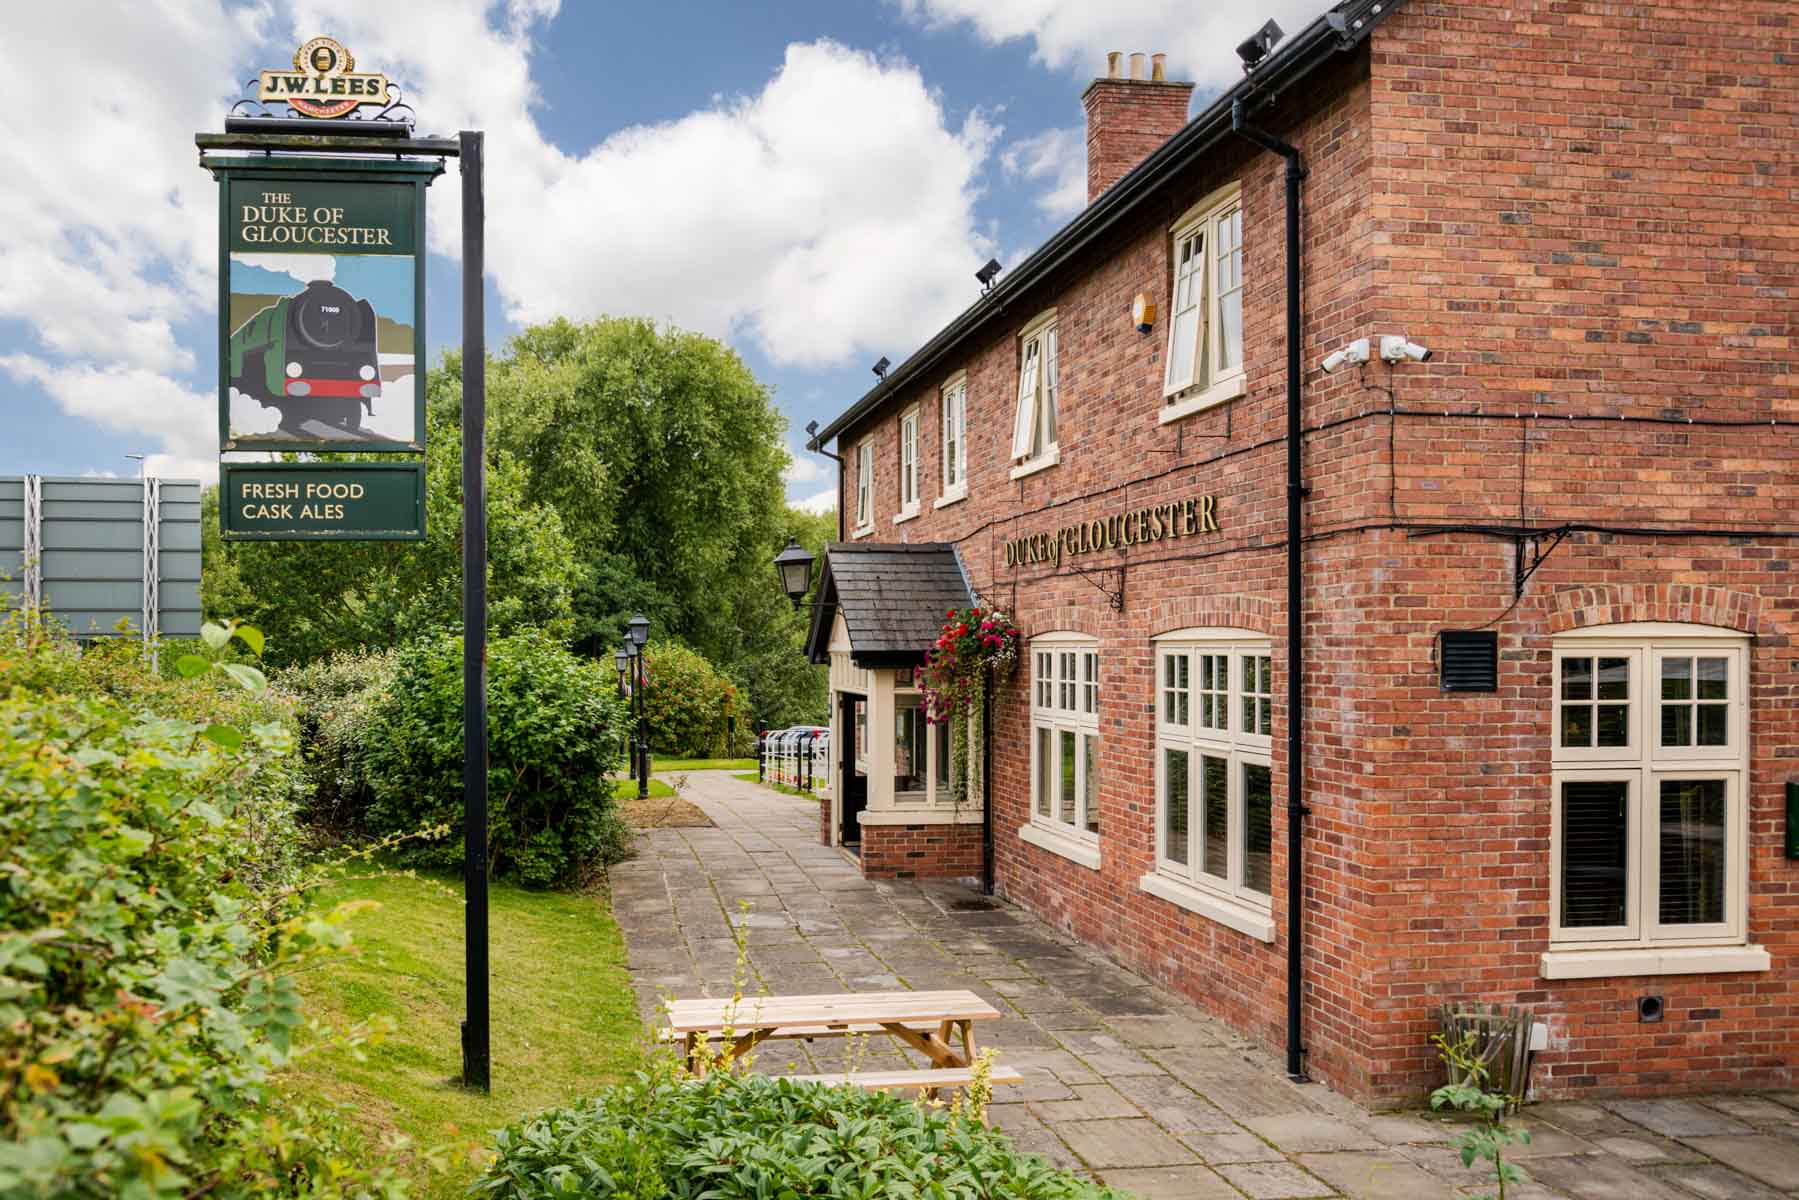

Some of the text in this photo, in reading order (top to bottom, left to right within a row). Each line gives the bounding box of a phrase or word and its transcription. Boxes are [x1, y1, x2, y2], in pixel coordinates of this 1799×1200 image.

[262, 192, 292, 204] THE
[242, 206, 344, 224] DUKE OF
[242, 225, 393, 245] GLOUCESTER
[242, 483, 364, 499] FRESH FOOD
[242, 504, 344, 520] CASK ALES
[1005, 531, 1048, 568] DUKE
[1064, 495, 1219, 556] GLOUCESTER
